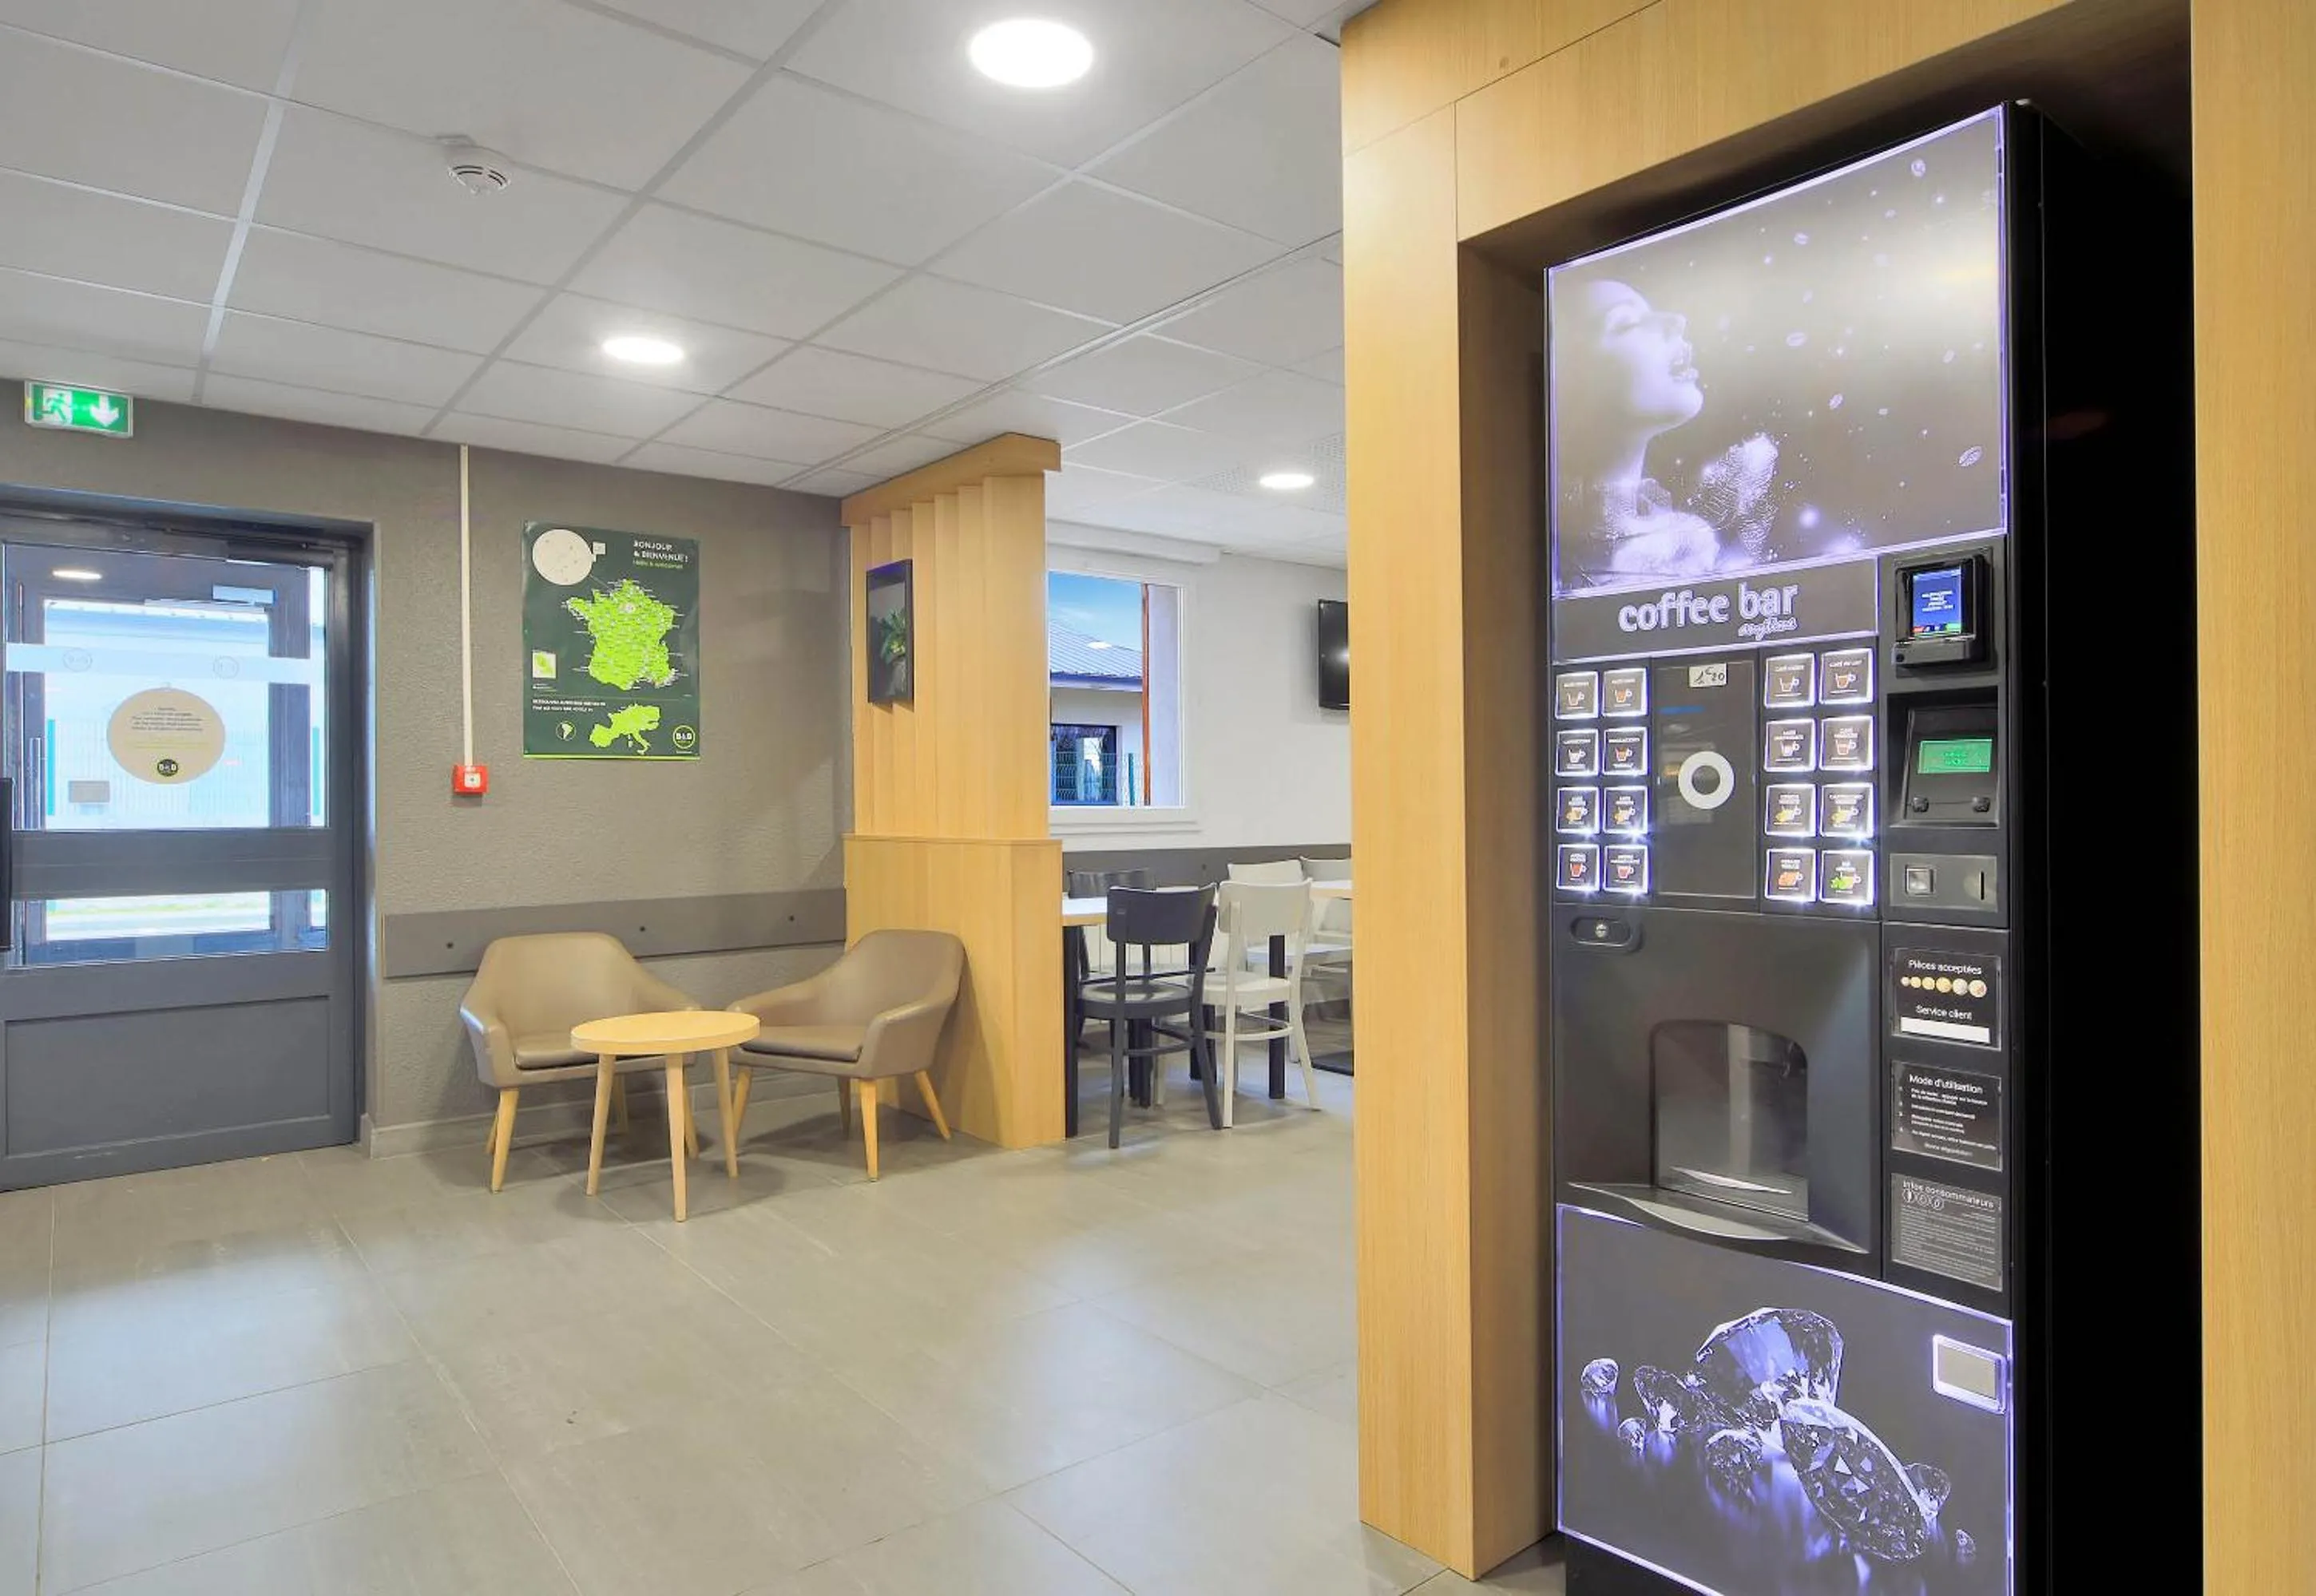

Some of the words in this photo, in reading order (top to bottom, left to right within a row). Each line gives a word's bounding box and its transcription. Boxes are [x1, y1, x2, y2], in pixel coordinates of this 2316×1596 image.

[633, 540, 672, 551] BONJOUR
[1618, 589, 1731, 632] coffee
[1737, 581, 1799, 620] bar
[1908, 960, 1937, 971] Pièces
[1915, 1004, 1947, 1016] Service
[1949, 1009, 1973, 1020] client
[1909, 1074, 1933, 1086] Mode
